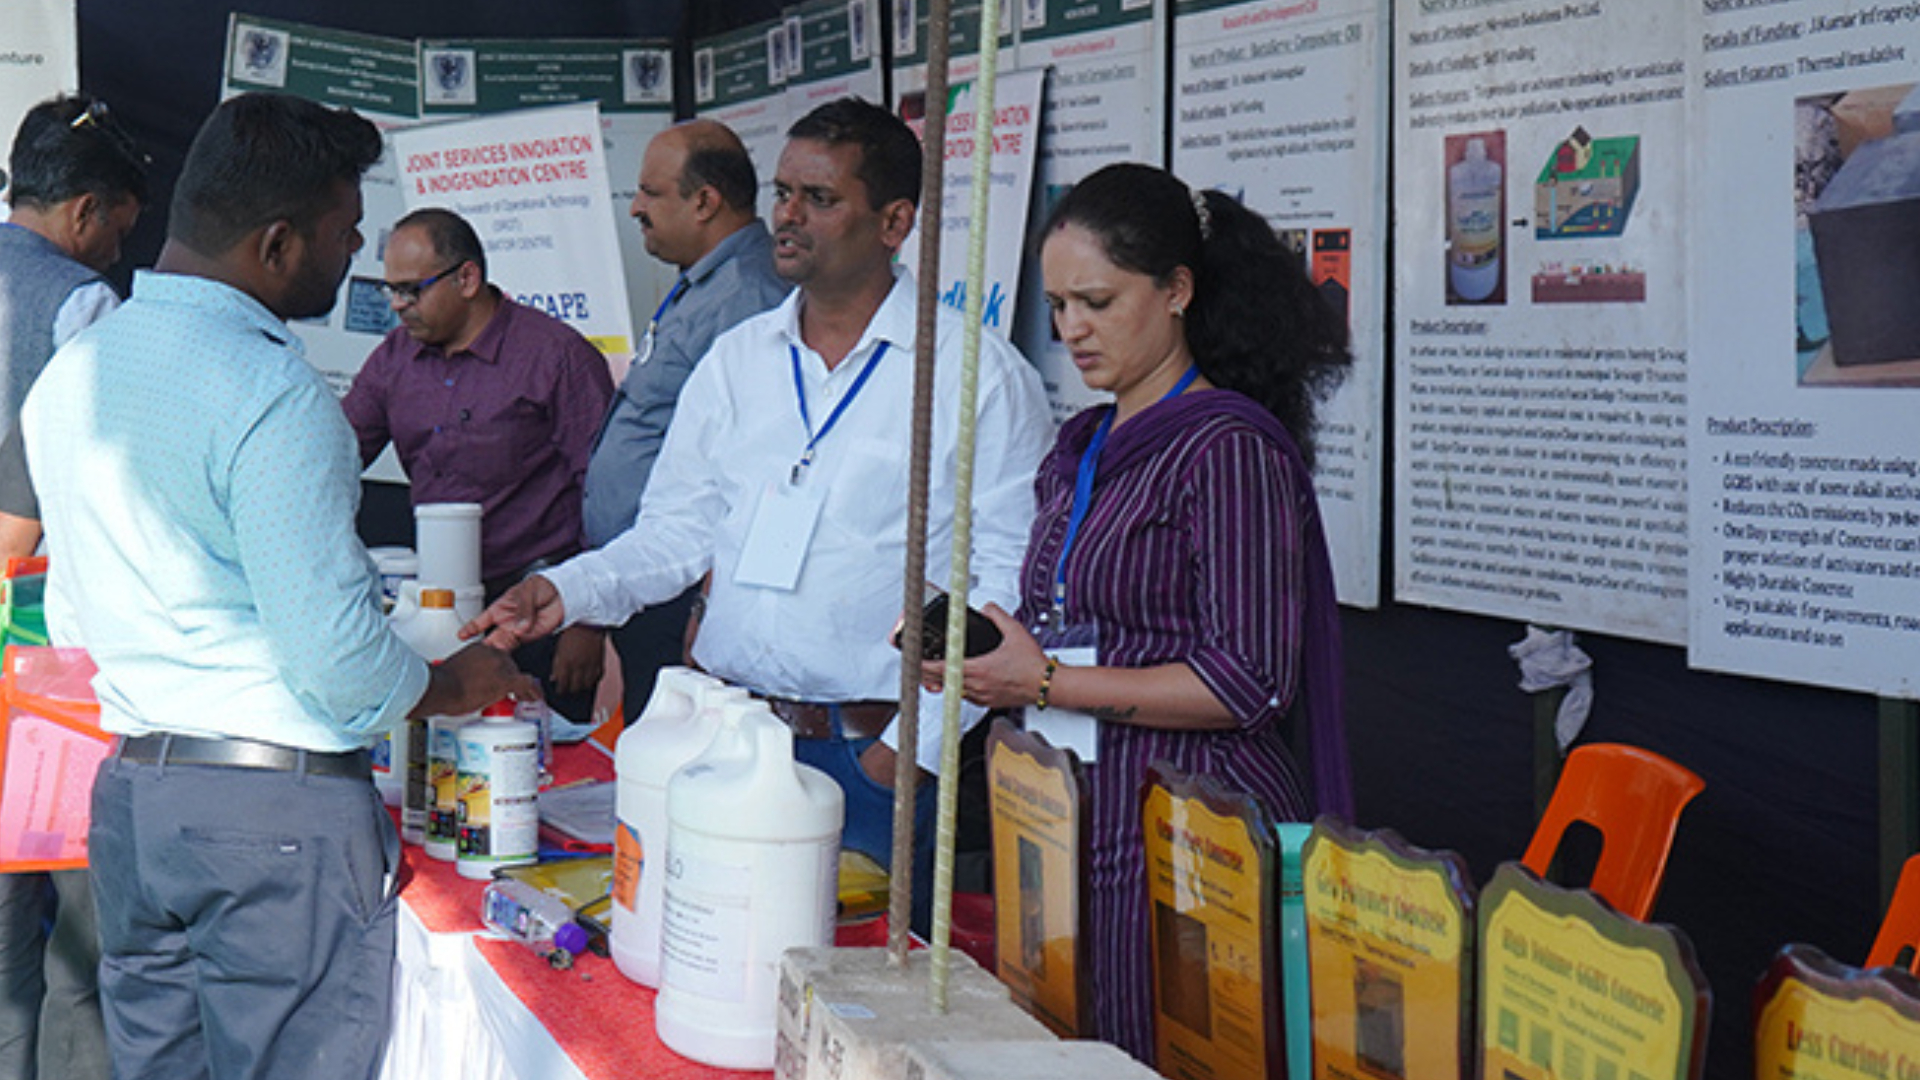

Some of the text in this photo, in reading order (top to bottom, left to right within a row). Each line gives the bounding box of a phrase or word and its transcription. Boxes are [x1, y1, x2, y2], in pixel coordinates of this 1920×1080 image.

[1704, 30, 1739, 51] Details
[1741, 27, 1754, 44] of
[1797, 51, 1845, 75] Thermal
[406, 134, 592, 174] JOINT SERVICES INNOVATION
[415, 176, 426, 195] &
[531, 160, 588, 183] CENTRE
[1707, 415, 1818, 438] Product Description:
[1799, 456, 1846, 471] concrete
[1848, 457, 1881, 473] made
[1883, 457, 1917, 478] using
[1755, 476, 1781, 492] with
[1782, 480, 1800, 494] use
[1804, 477, 1818, 494] of
[1820, 481, 1850, 496] some
[1852, 480, 1883, 497] alkali
[1811, 505, 1868, 524] emissions
[1869, 506, 1883, 527] by
[1723, 521, 1915, 552] One Day strength of Concrete can
[1723, 549, 1912, 578] proper selection of activators and
[1723, 571, 1854, 599] Highly Durable Concrete
[1724, 594, 1750, 615] Very
[1752, 599, 1798, 617] suitable
[1801, 601, 1822, 619] for
[1723, 619, 1844, 648] applications and so on
[1610, 977, 1665, 1025] Concrete
[1787, 1019, 1823, 1060] Less
[1829, 1033, 1890, 1079] Curing
